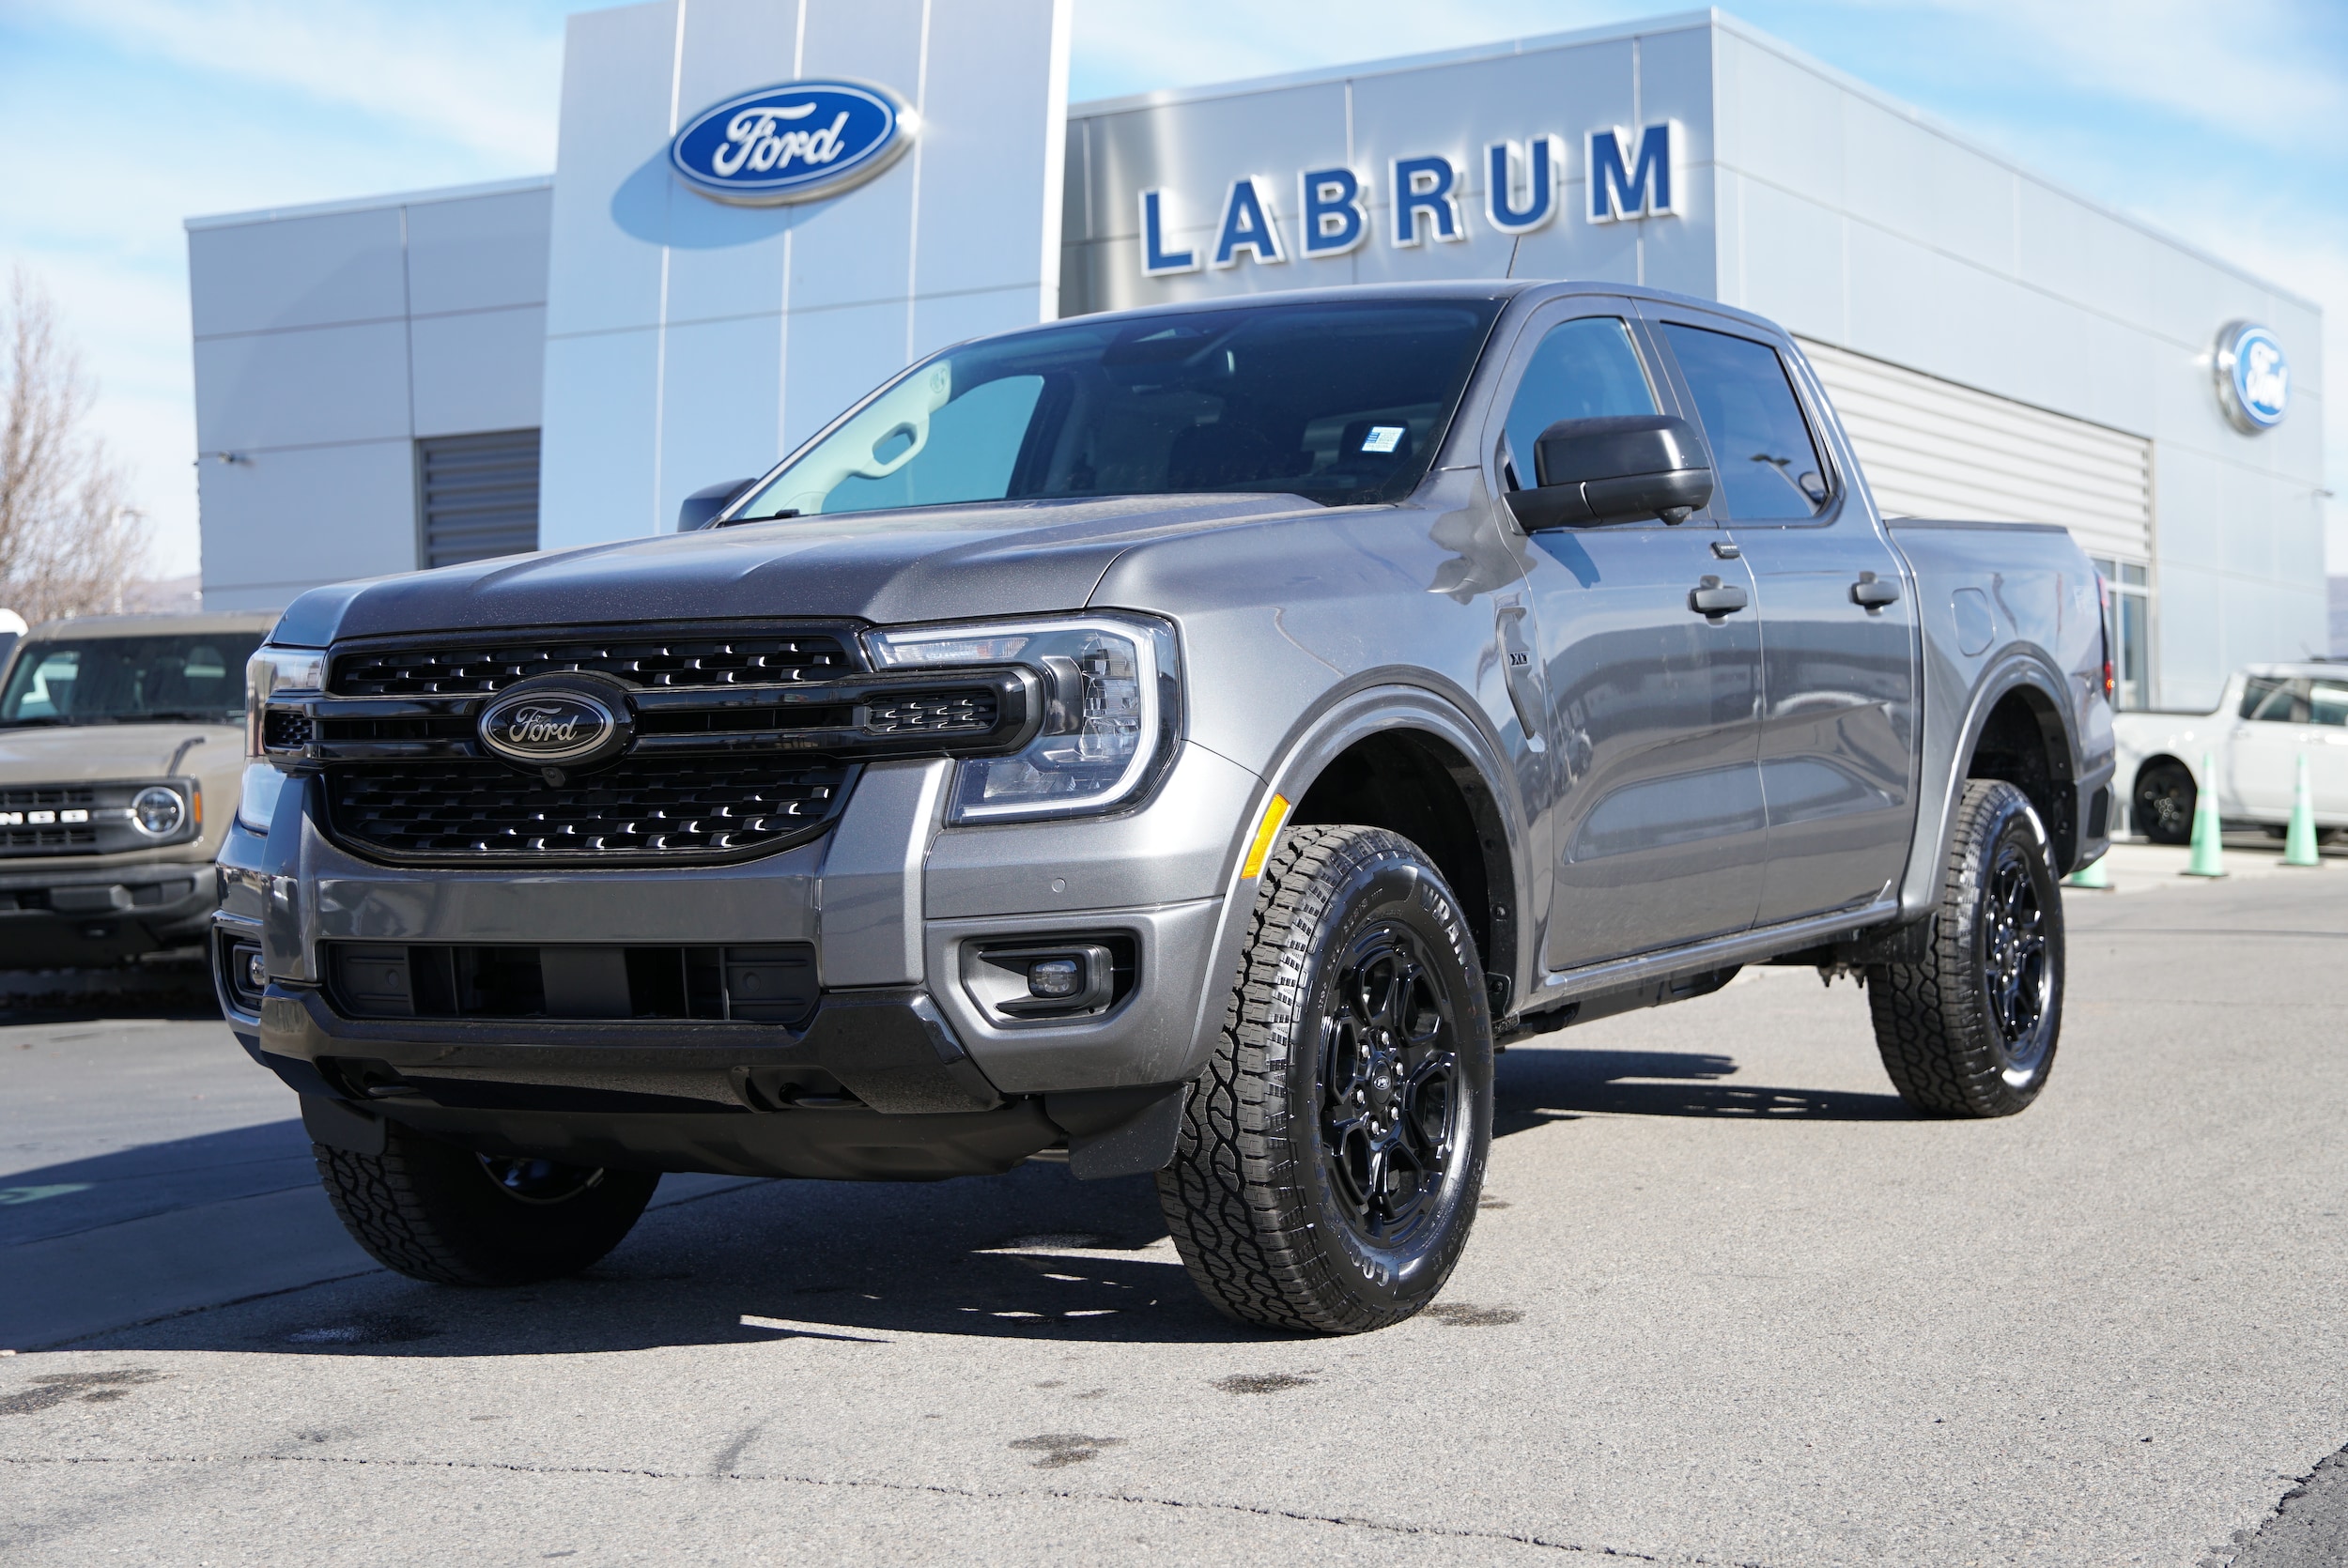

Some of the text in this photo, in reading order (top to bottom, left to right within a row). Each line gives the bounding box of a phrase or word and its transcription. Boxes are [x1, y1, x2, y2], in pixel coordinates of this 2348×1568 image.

[711, 101, 850, 177] Ford
[1137, 118, 1680, 277] LABRUM
[508, 705, 579, 743] Ford
